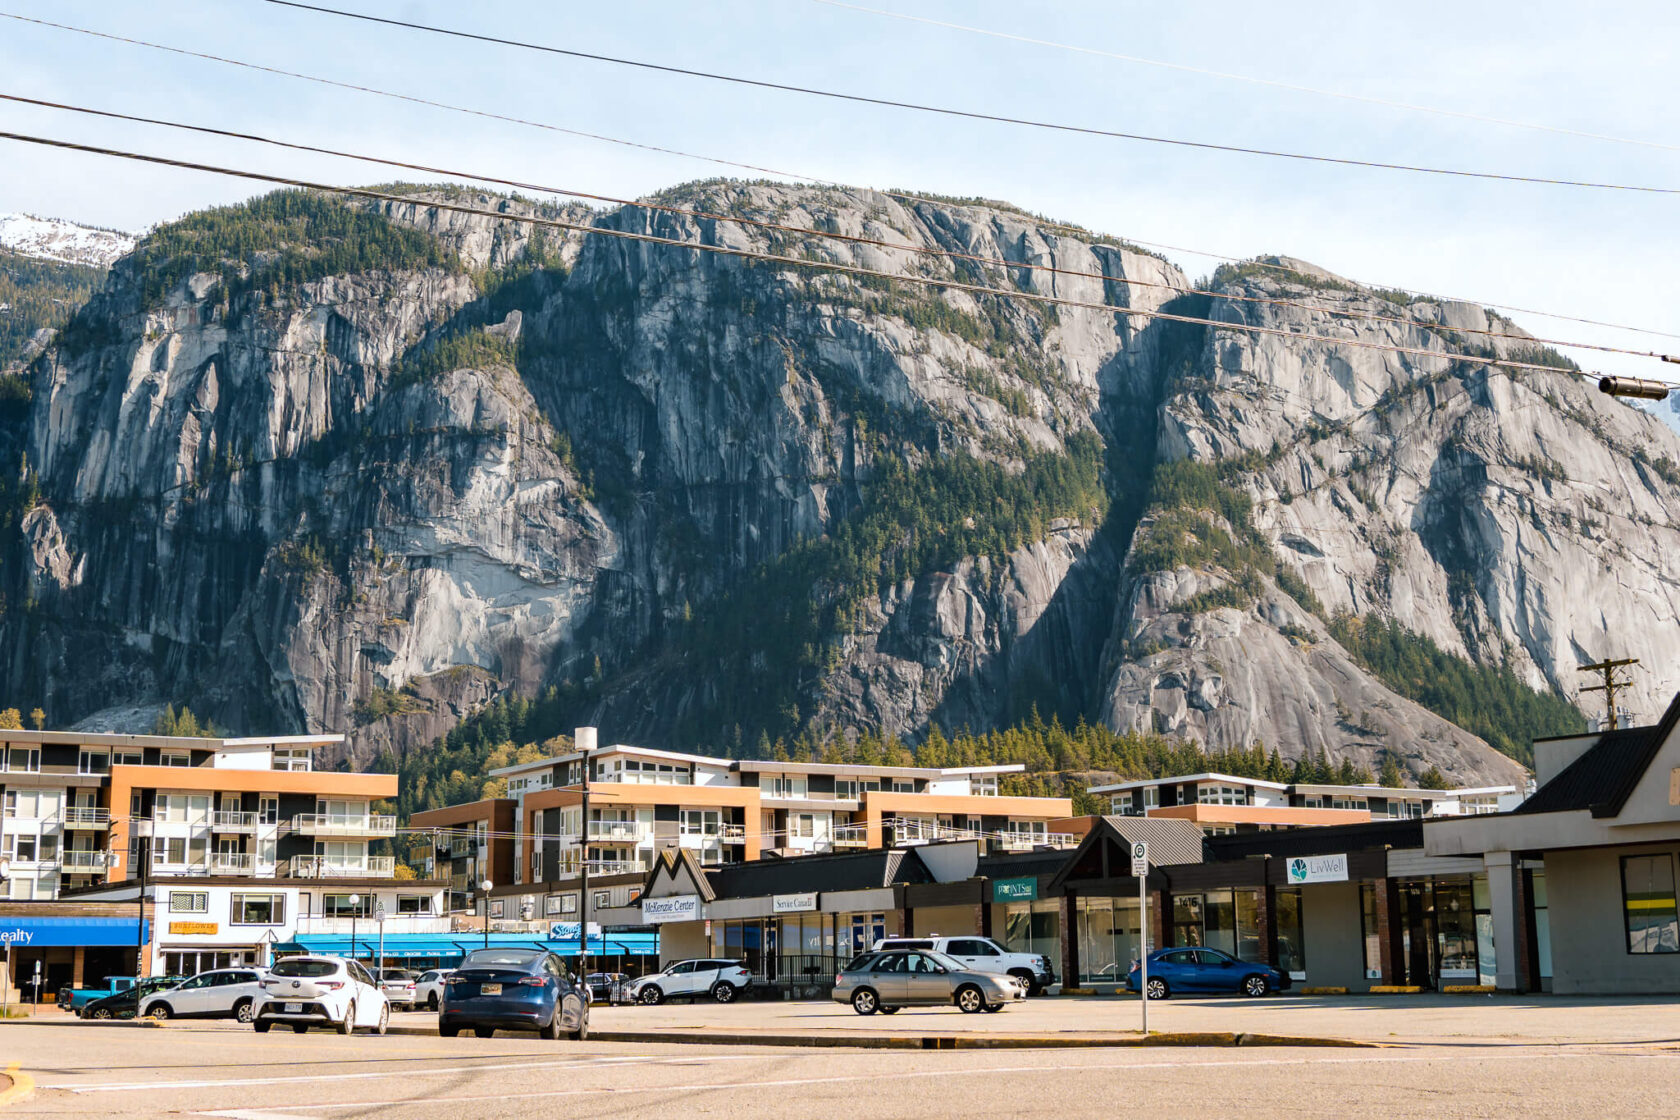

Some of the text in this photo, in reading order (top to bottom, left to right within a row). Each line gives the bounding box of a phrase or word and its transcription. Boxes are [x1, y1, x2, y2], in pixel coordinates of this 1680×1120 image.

[1310, 858, 1344, 873] LivWell
[645, 900, 695, 913] McKenzie Center
[777, 897, 812, 909] Service Canada
[0, 928, 34, 945] ealty
